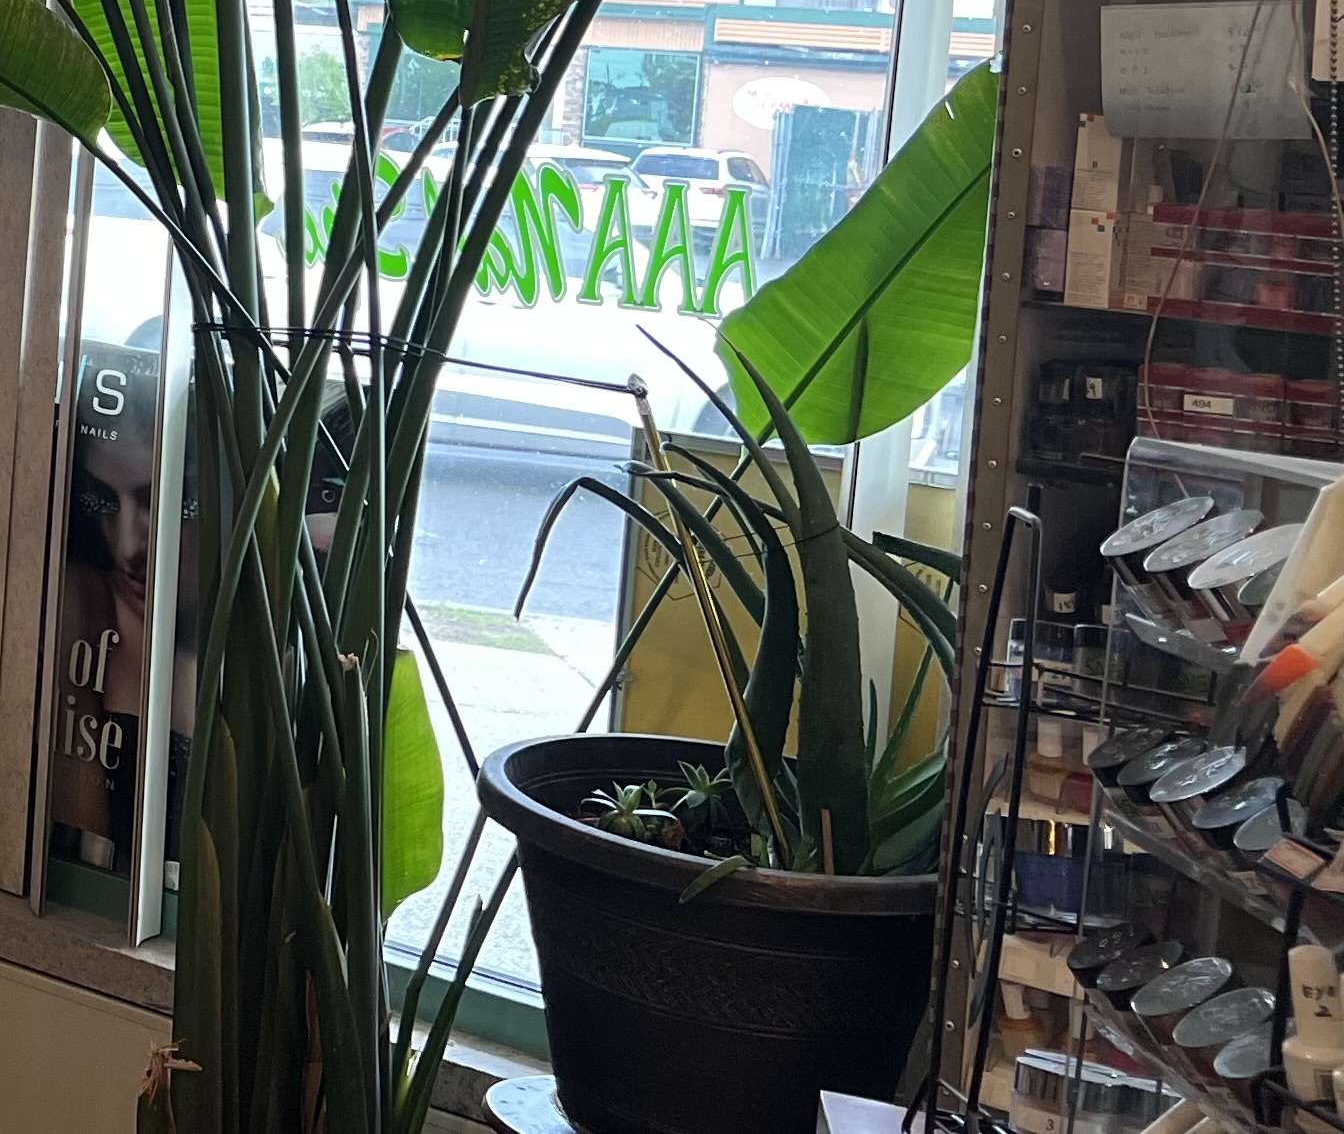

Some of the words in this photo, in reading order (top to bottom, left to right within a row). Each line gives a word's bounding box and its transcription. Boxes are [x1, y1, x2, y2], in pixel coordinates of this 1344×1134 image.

[1192, 399, 1212, 409] 494
[81, 424, 118, 441] NAILS
[69, 629, 120, 694] of
